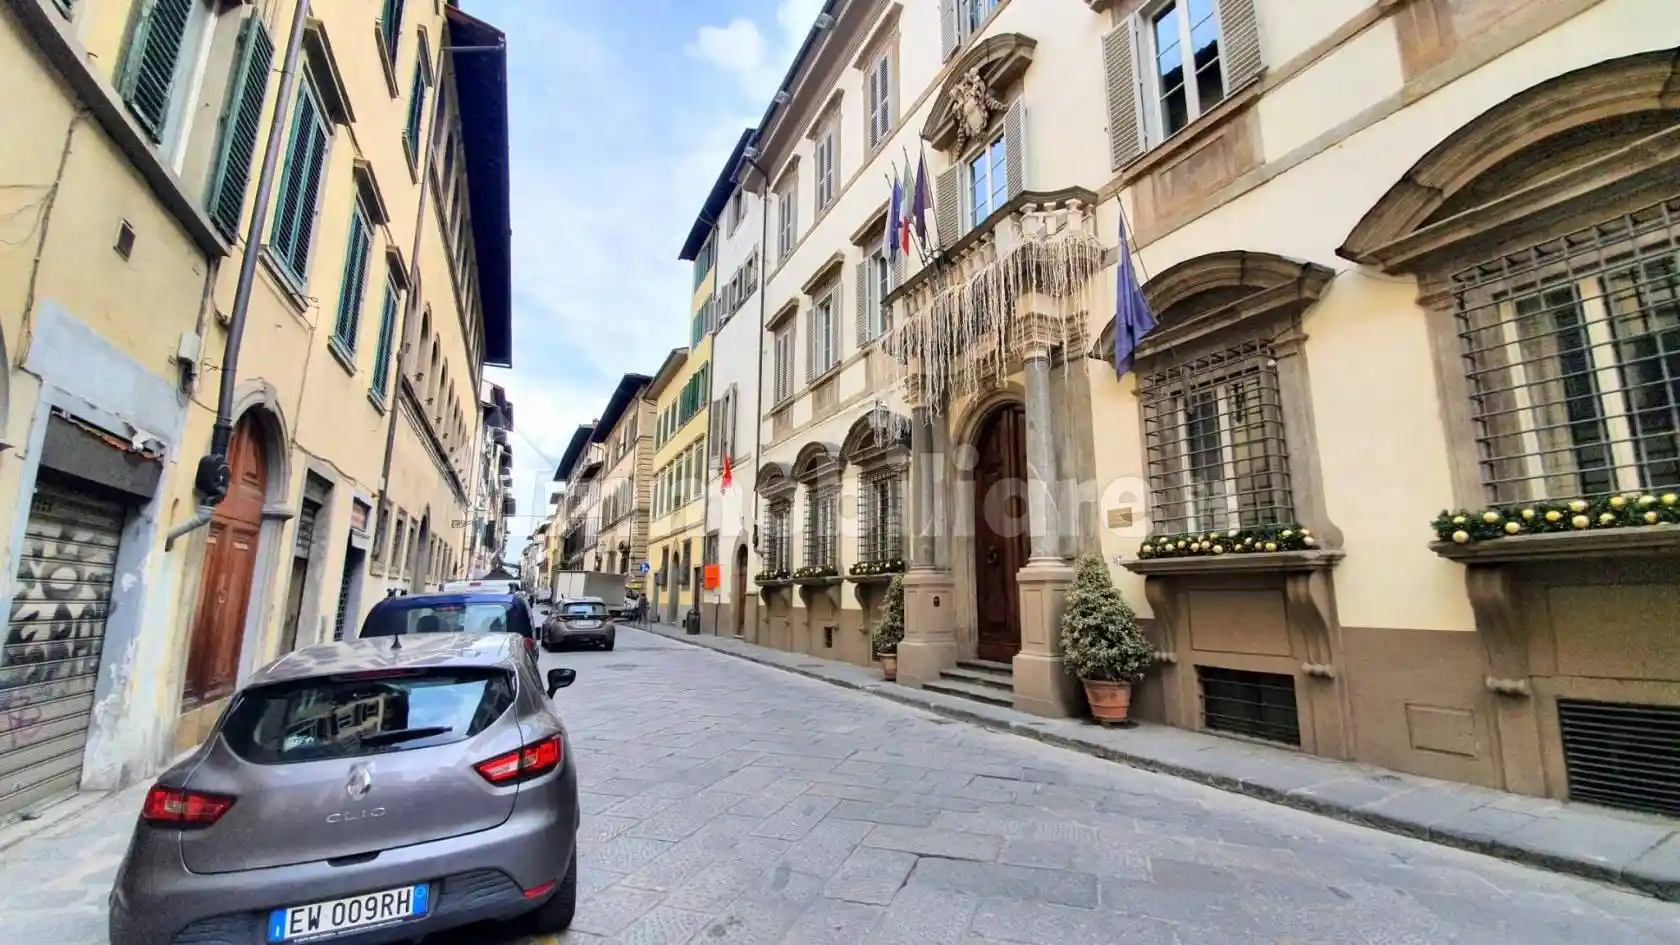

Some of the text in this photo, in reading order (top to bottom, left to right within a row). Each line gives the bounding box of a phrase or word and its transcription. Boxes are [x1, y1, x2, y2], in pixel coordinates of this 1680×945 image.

[327, 807, 386, 824] CLIO
[288, 905, 321, 935] EW
[331, 889, 412, 927] 009RH
